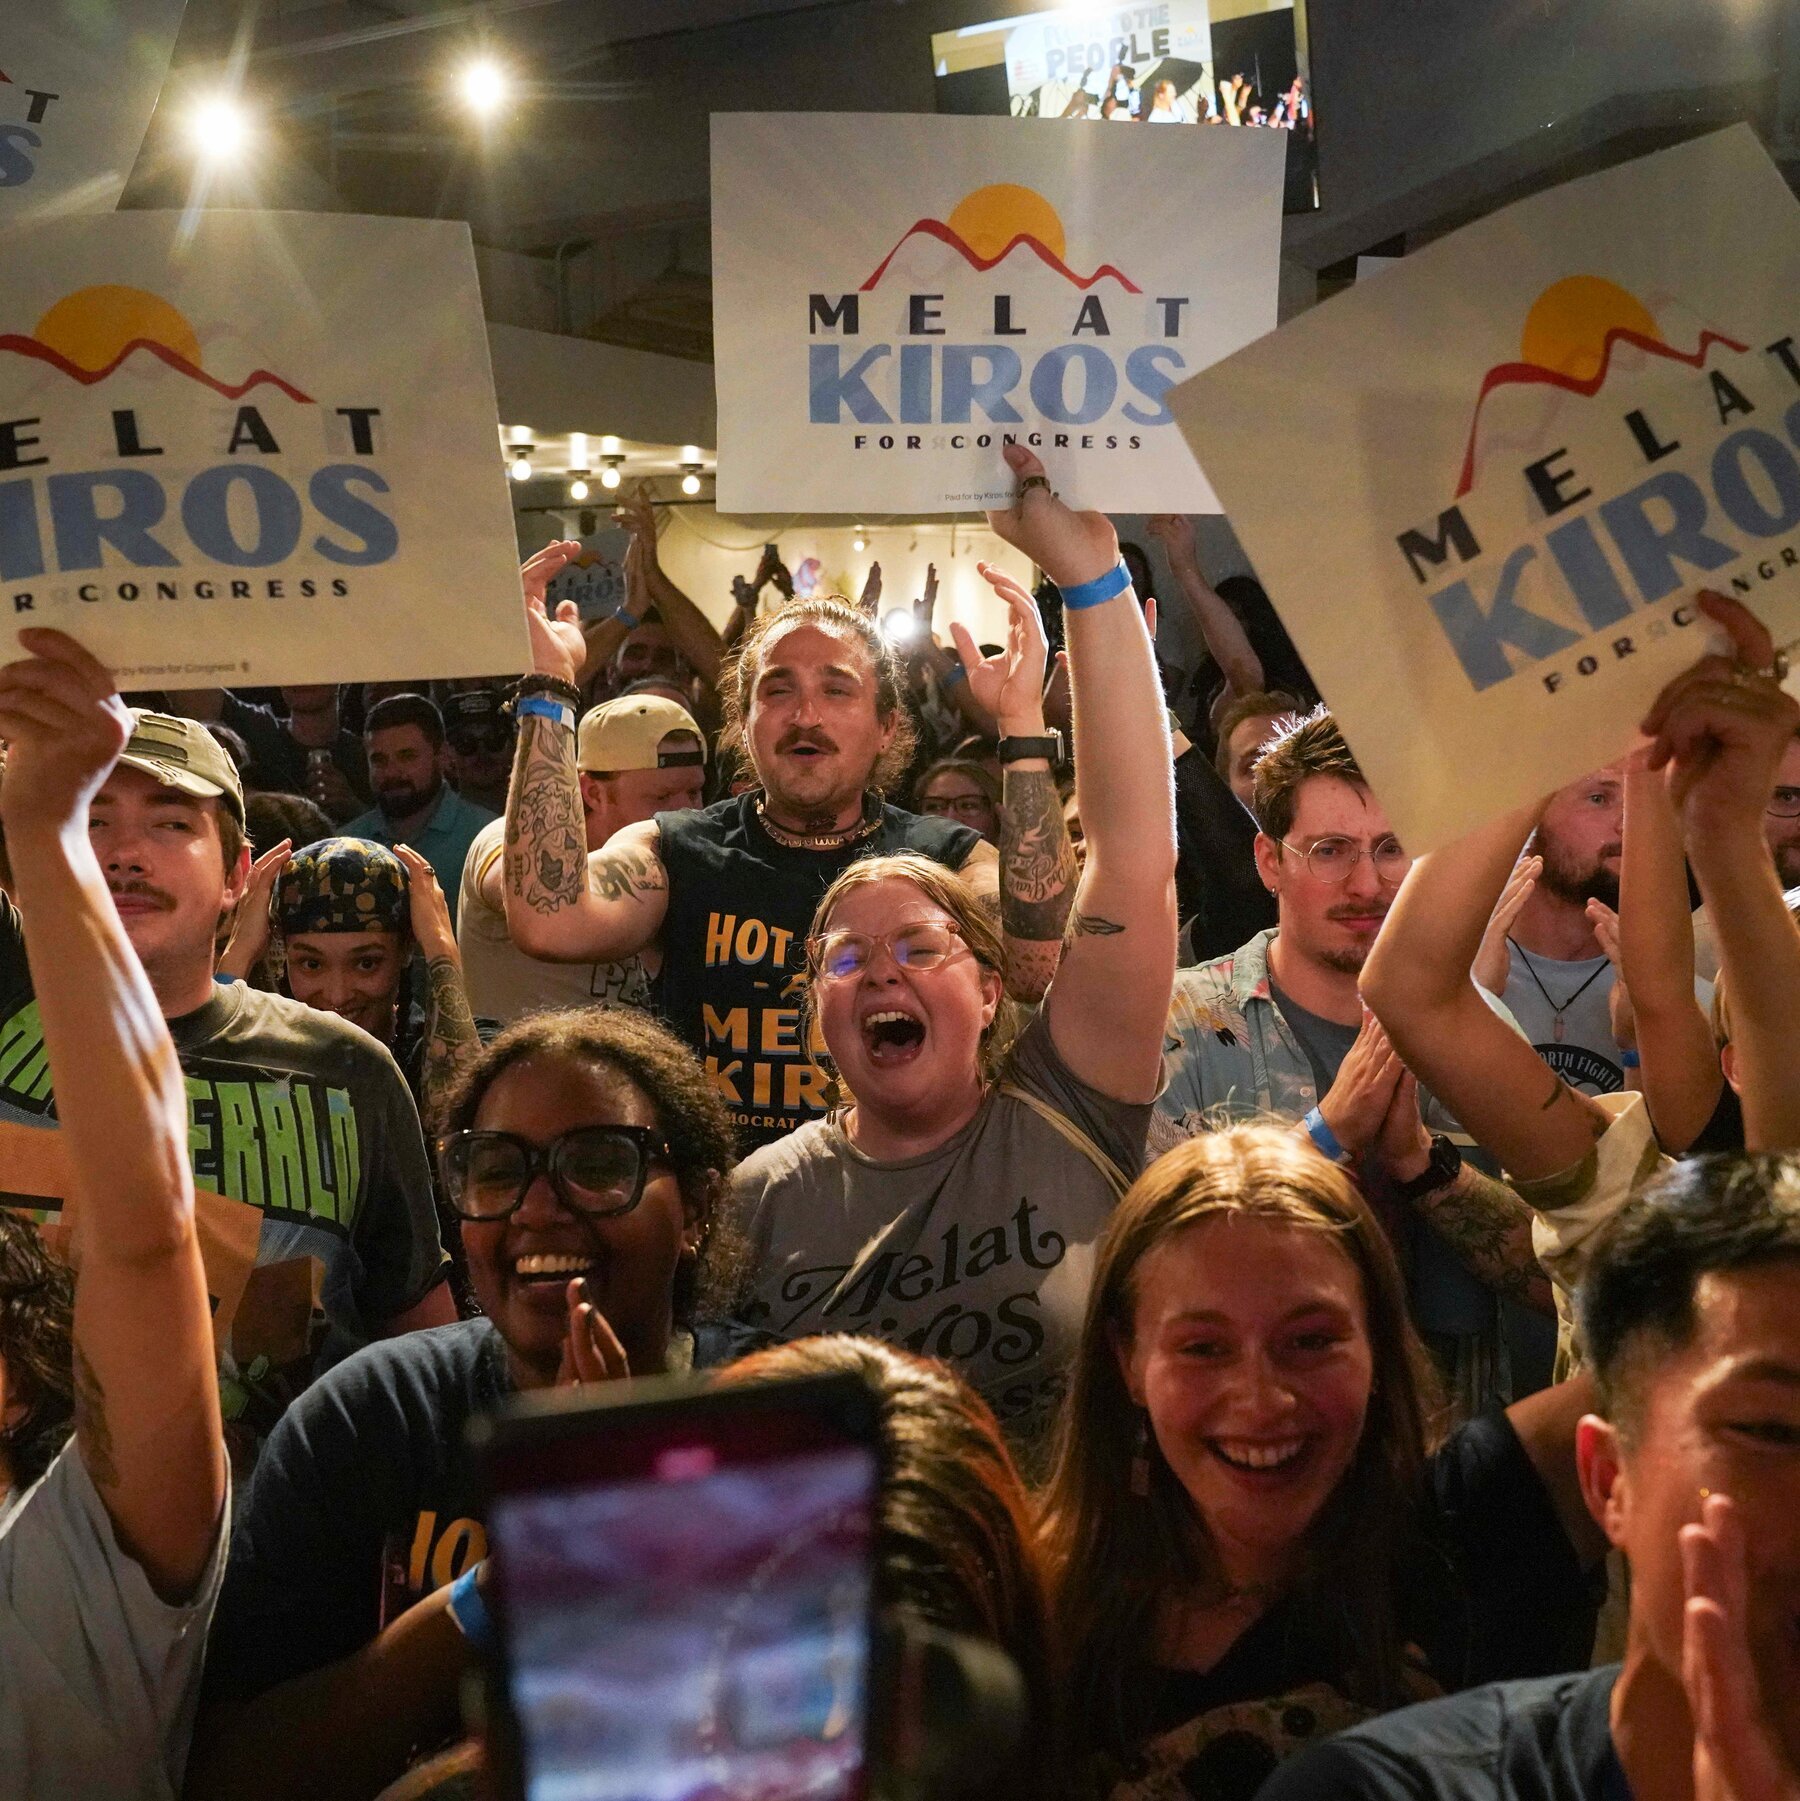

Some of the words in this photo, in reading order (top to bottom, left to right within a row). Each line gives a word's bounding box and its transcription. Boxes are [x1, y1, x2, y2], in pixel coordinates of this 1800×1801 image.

[809, 294, 1189, 337] MELAT
[808, 343, 1186, 425] KIROS
[0, 406, 380, 470] ELAT
[854, 434, 922, 450] FOR
[950, 432, 1141, 450] CONGRESS
[1396, 336, 1800, 586] MELAT
[0, 464, 397, 582] IROS
[78, 579, 349, 602] CONGRESS
[1542, 635, 1637, 694] FOR
[1672, 546, 1800, 628] CNGR
[705, 912, 793, 968] HOT
[704, 1055, 834, 1112] KIR
[1539, 1051, 1575, 1068] ORTH
[729, 1111, 797, 1129] MOCRAT
[781, 1196, 1067, 1332] Melat
